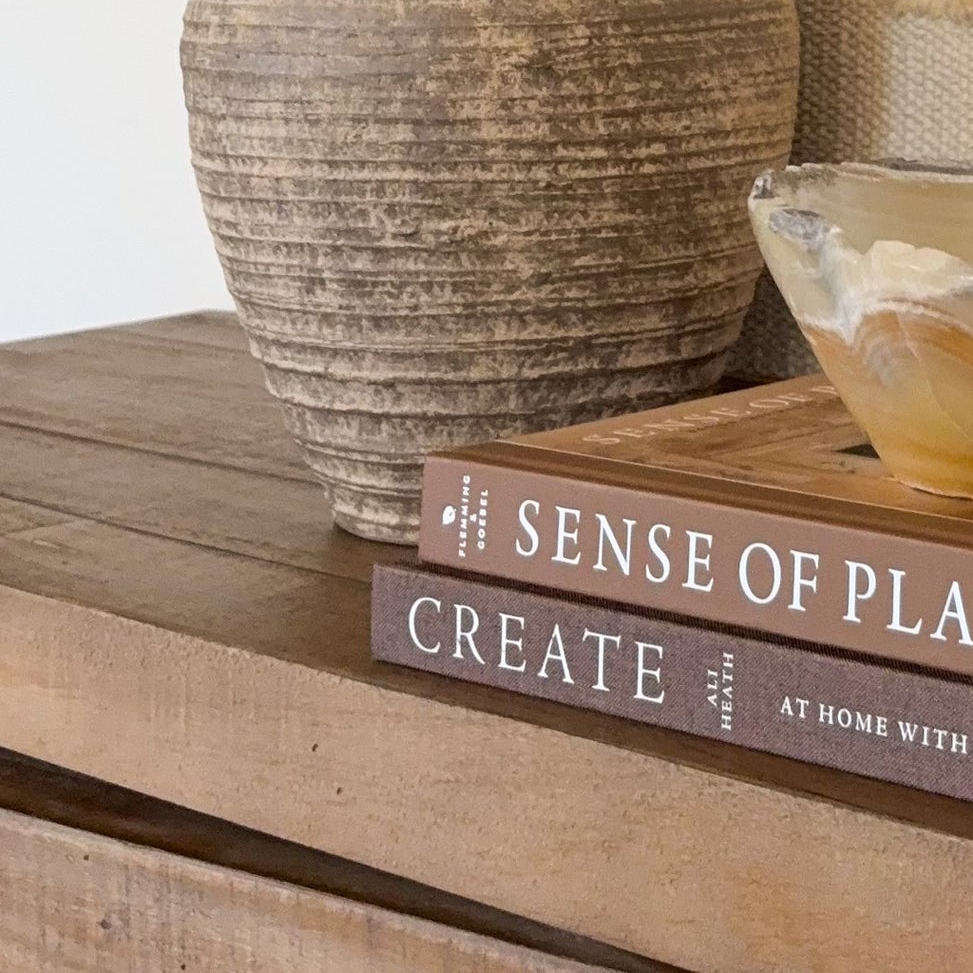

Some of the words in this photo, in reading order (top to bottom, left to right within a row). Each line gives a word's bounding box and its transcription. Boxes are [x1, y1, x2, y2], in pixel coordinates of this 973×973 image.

[458, 474, 471, 557] FLEMMING
[477, 489, 489, 550] GOEBEL
[515, 499, 714, 593] SENSE
[738, 542, 820, 612] OF
[408, 597, 665, 704] CREATE
[706, 669, 718, 707] ALI
[721, 652, 734, 731] HEATH
[780, 696, 810, 719] AT
[819, 703, 888, 737] HOME
[897, 721, 969, 754] WITH
